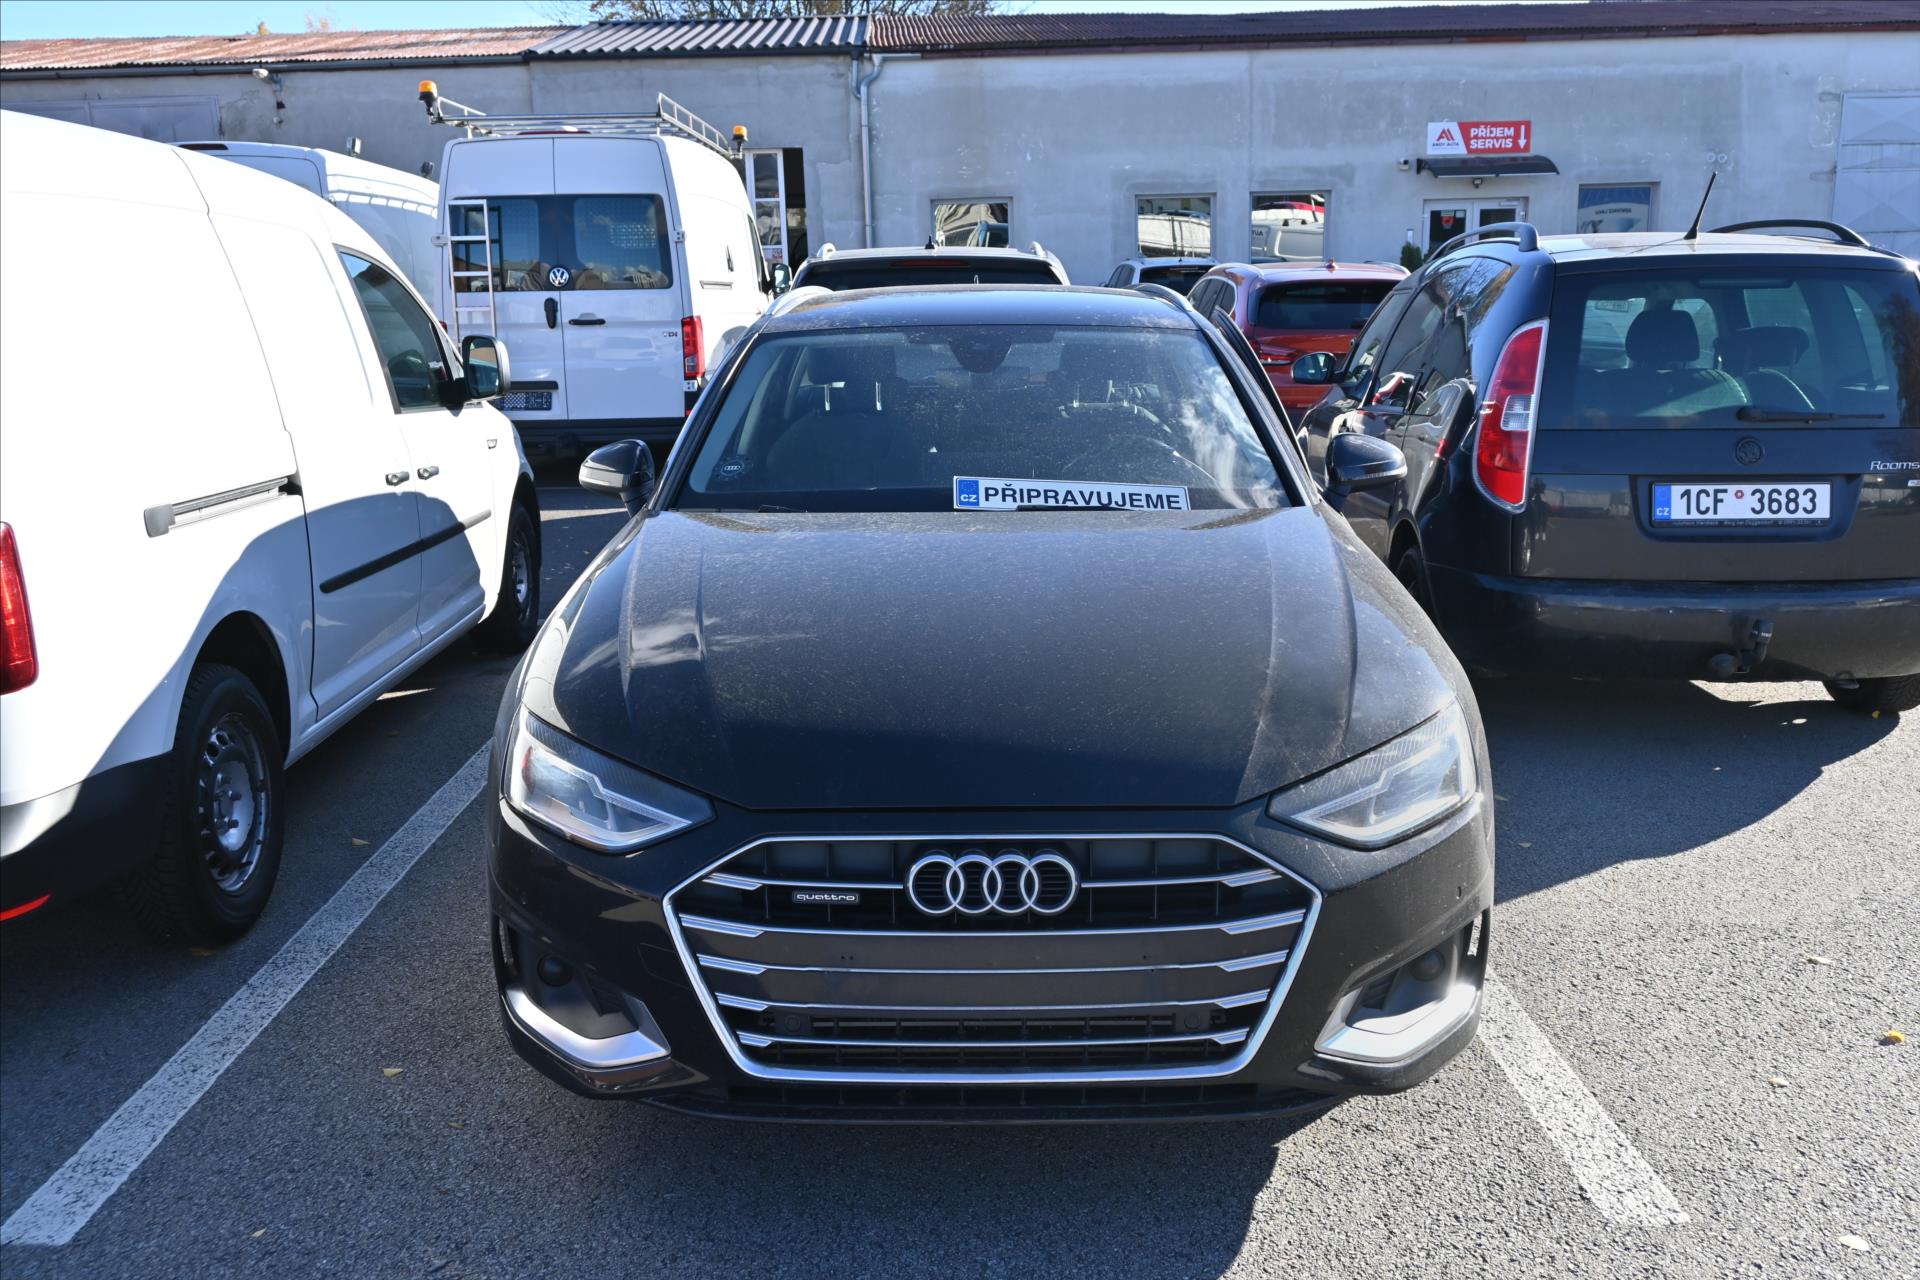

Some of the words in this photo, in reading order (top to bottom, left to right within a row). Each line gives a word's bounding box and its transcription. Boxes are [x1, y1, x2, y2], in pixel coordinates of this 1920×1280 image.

[1470, 125, 1514, 137] PŘÍJEM
[1470, 138, 1513, 149] SERVIS
[960, 493, 977, 502] CZ
[983, 483, 1183, 510] PŘIPRAVUJEME
[1656, 507, 1670, 516] CZ
[1680, 488, 1728, 516] 1CF
[1750, 488, 1817, 515] 3683
